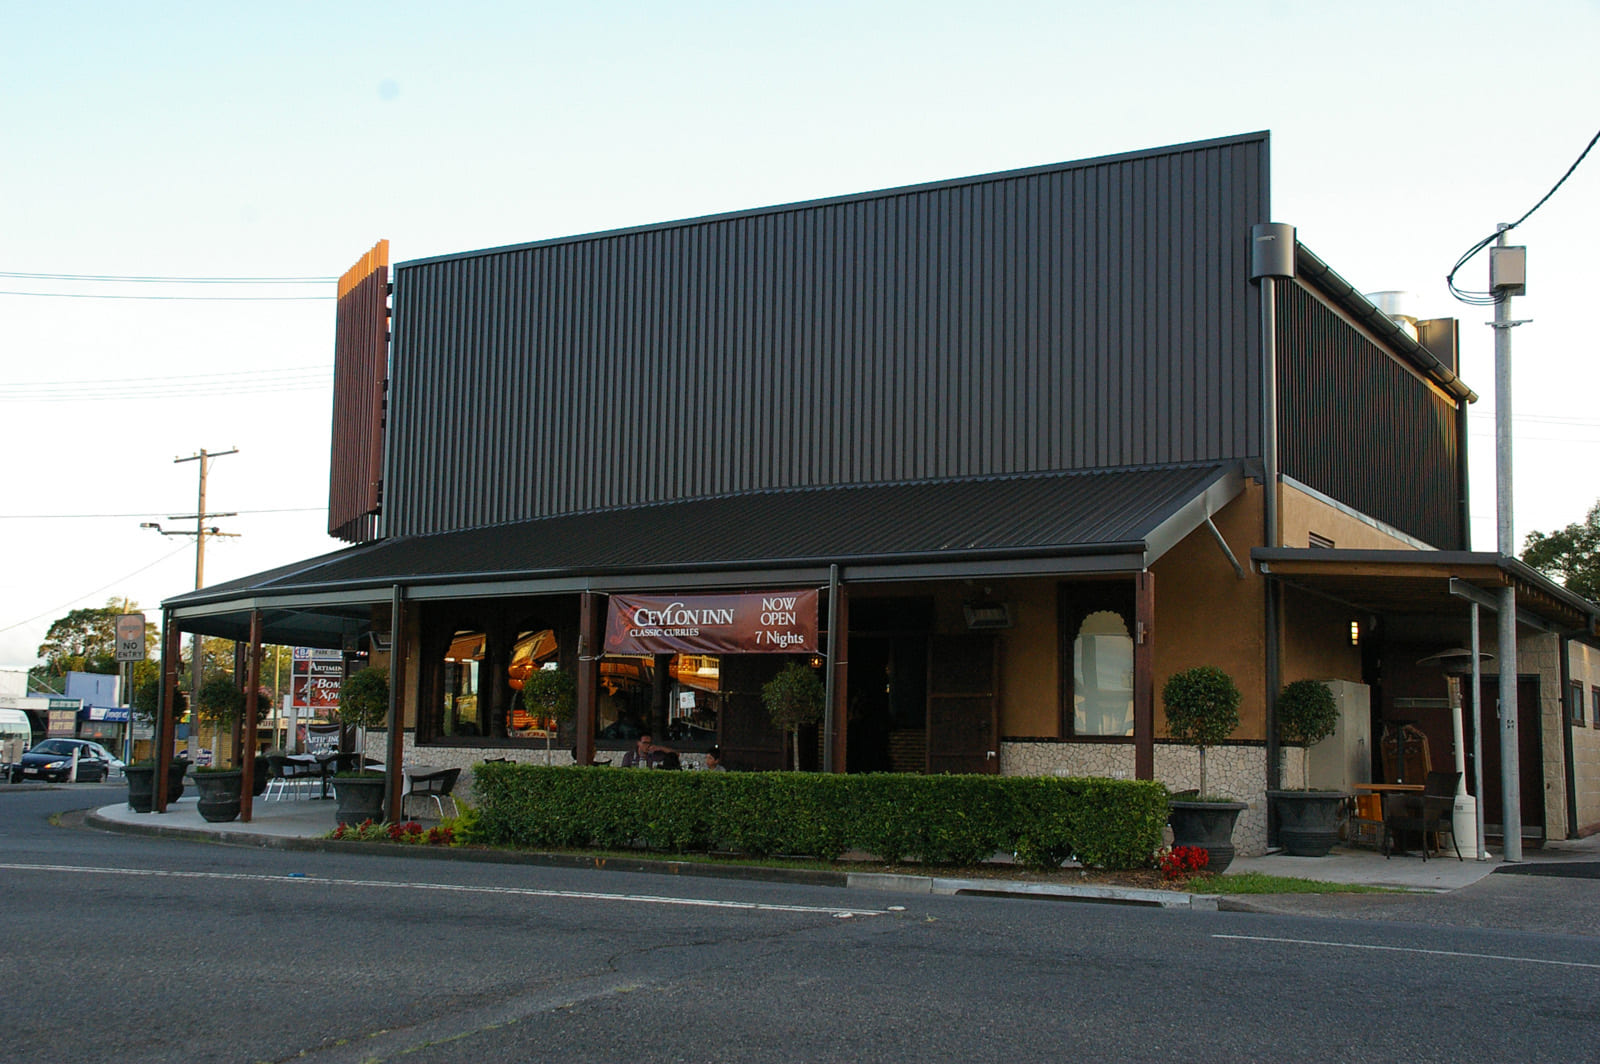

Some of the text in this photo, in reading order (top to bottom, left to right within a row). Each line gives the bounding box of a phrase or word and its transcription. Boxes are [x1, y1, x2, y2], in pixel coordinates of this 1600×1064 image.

[762, 597, 797, 611] NOW
[633, 602, 735, 627] CEYLON INN
[760, 612, 796, 626] OPEN
[629, 628, 699, 638] CLASSIC CURRIES
[755, 630, 804, 648] 7 Nights
[122, 642, 138, 650] NO
[118, 651, 143, 659] ENTRY
[310, 661, 343, 672] ARTIMIN
